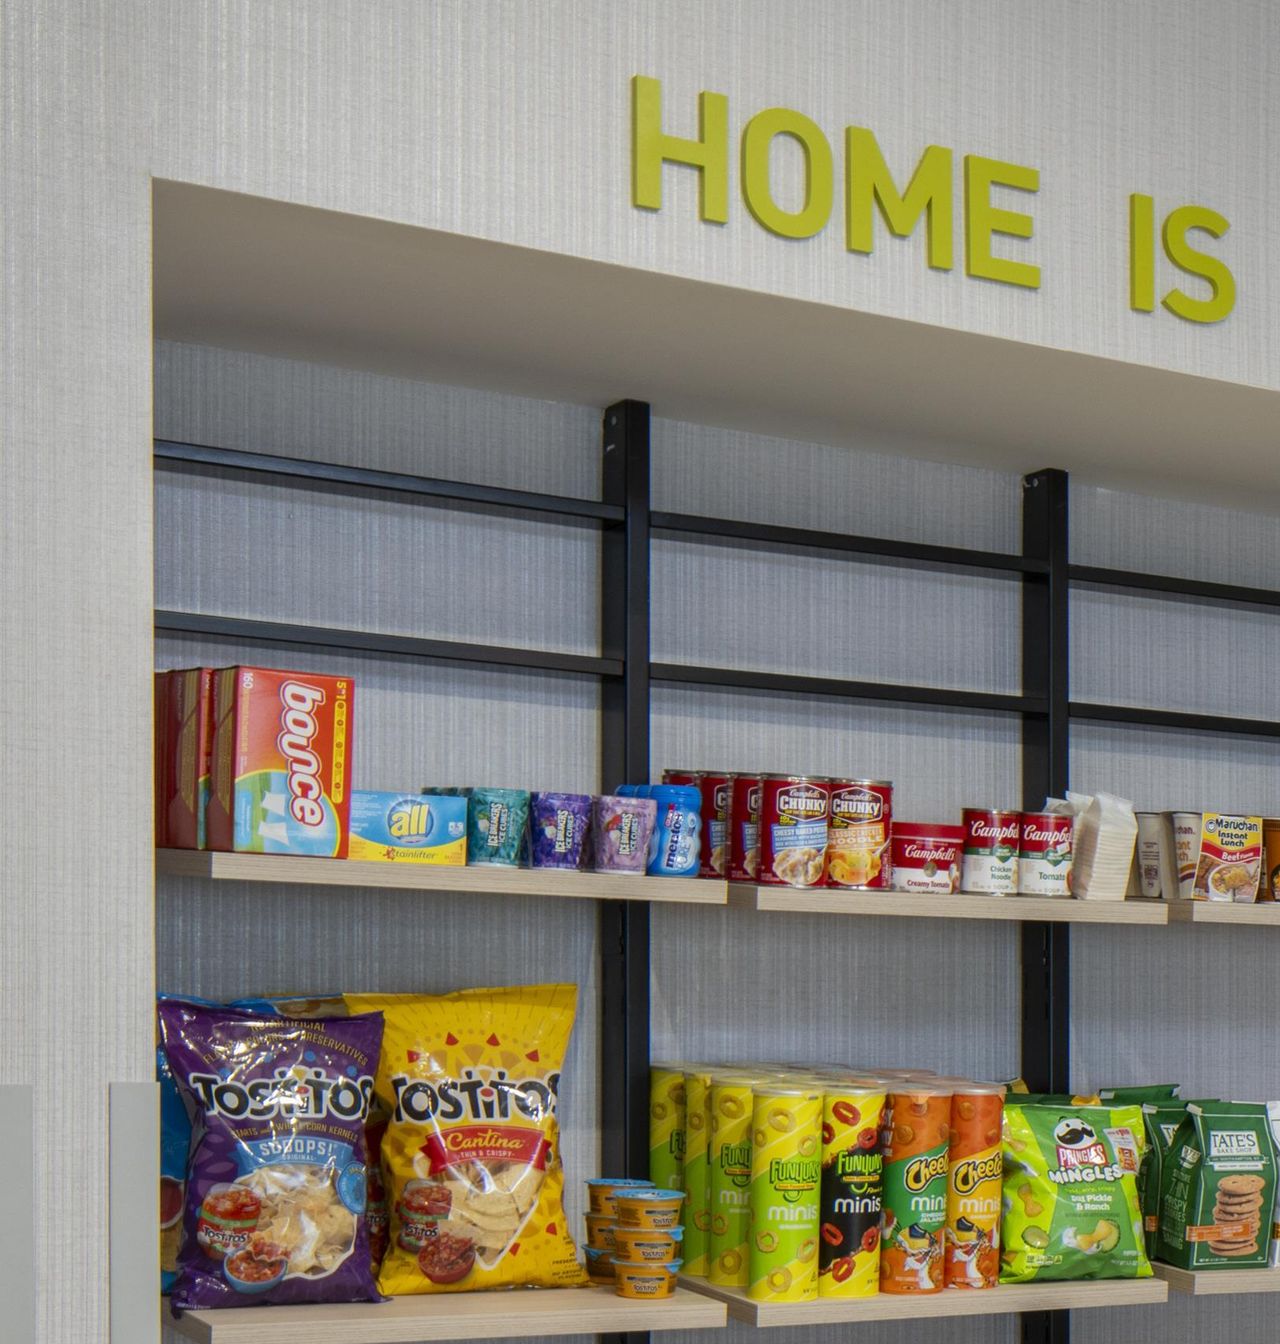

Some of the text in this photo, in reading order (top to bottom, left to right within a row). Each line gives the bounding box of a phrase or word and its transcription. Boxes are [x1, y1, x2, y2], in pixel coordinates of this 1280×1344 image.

[631, 73, 1041, 290] HOME
[1129, 192, 1237, 324] IS
[280, 681, 326, 828] bounce
[779, 795, 827, 813] CHUNKY
[832, 798, 880, 816] CHUNKY
[390, 804, 431, 838] all
[1213, 818, 1258, 833] Maruchan
[1217, 830, 1248, 841] Instant
[1220, 838, 1245, 848] Lunch
[903, 843, 956, 861] Campbell's
[1221, 851, 1240, 862] Beef
[446, 1128, 524, 1151] Cantina
[1211, 1133, 1257, 1149] TATE'S
[1058, 1145, 1106, 1167] PRINGLES
[767, 1203, 818, 1221] minis
[833, 1196, 881, 1214] minis
